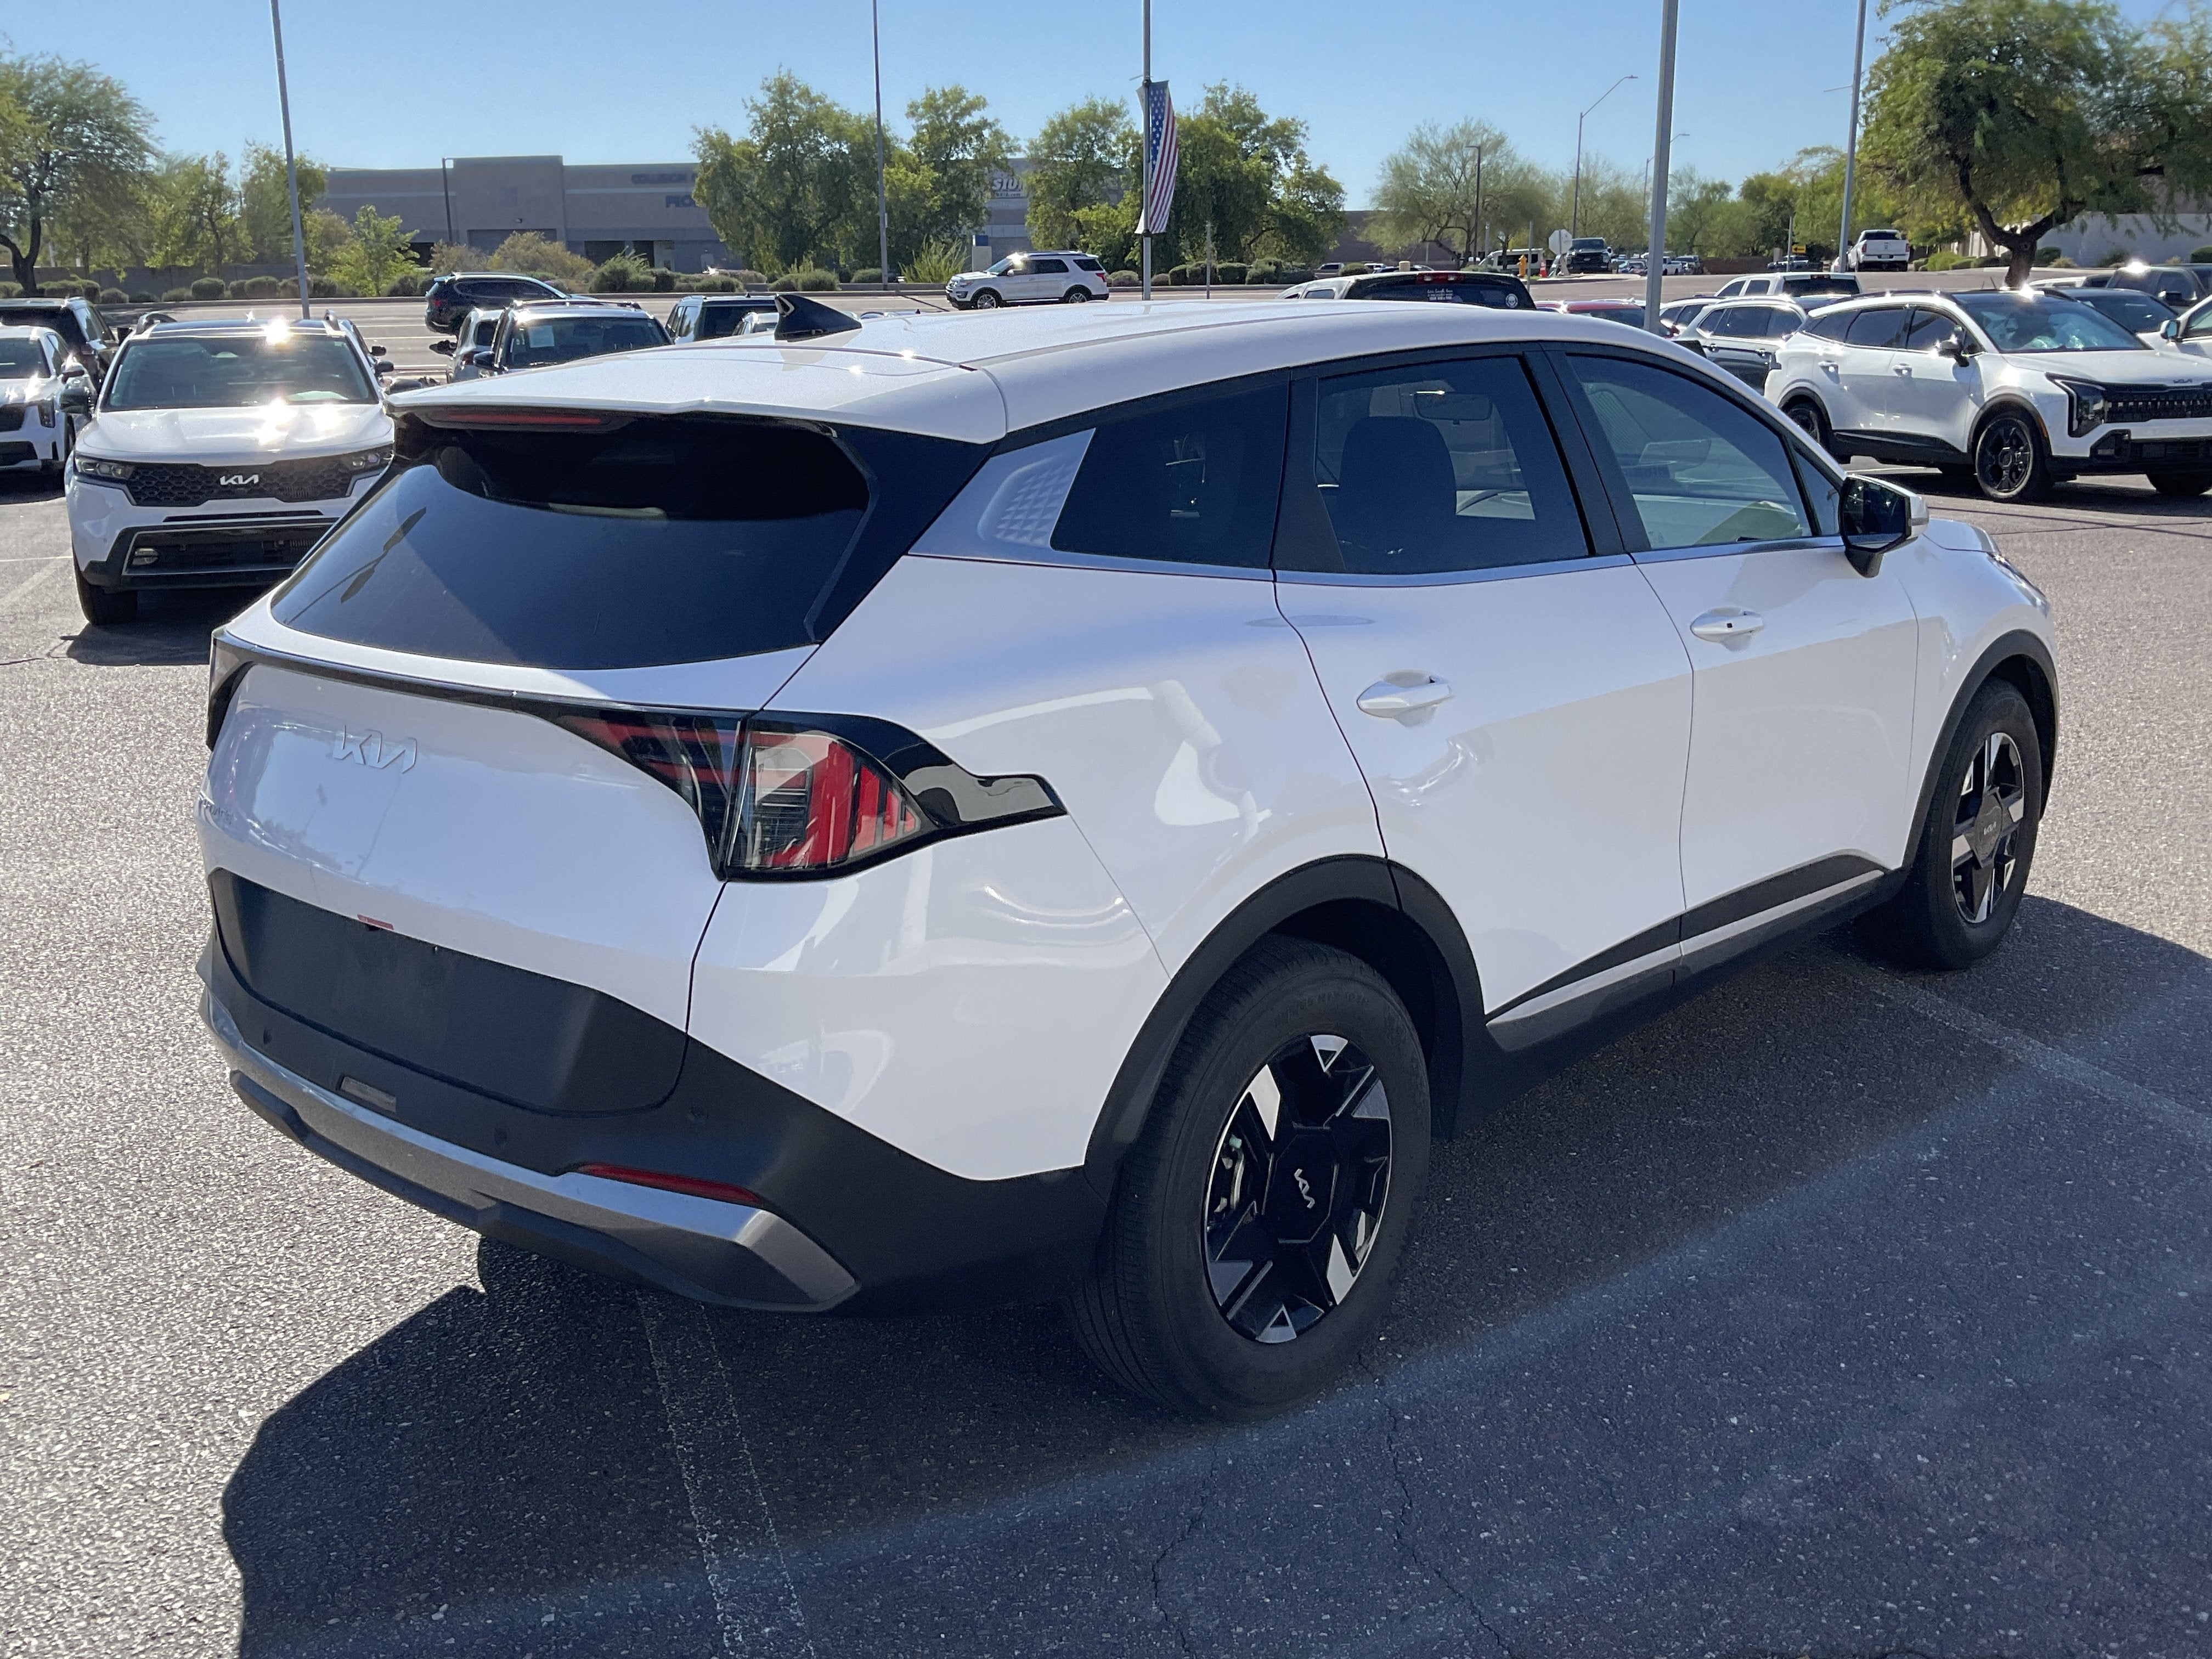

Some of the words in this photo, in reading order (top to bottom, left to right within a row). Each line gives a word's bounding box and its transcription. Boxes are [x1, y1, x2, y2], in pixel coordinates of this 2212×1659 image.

[219, 474, 259, 486] KIA
[332, 724, 417, 774] KIA
[1294, 1168, 1316, 1210] KIA
